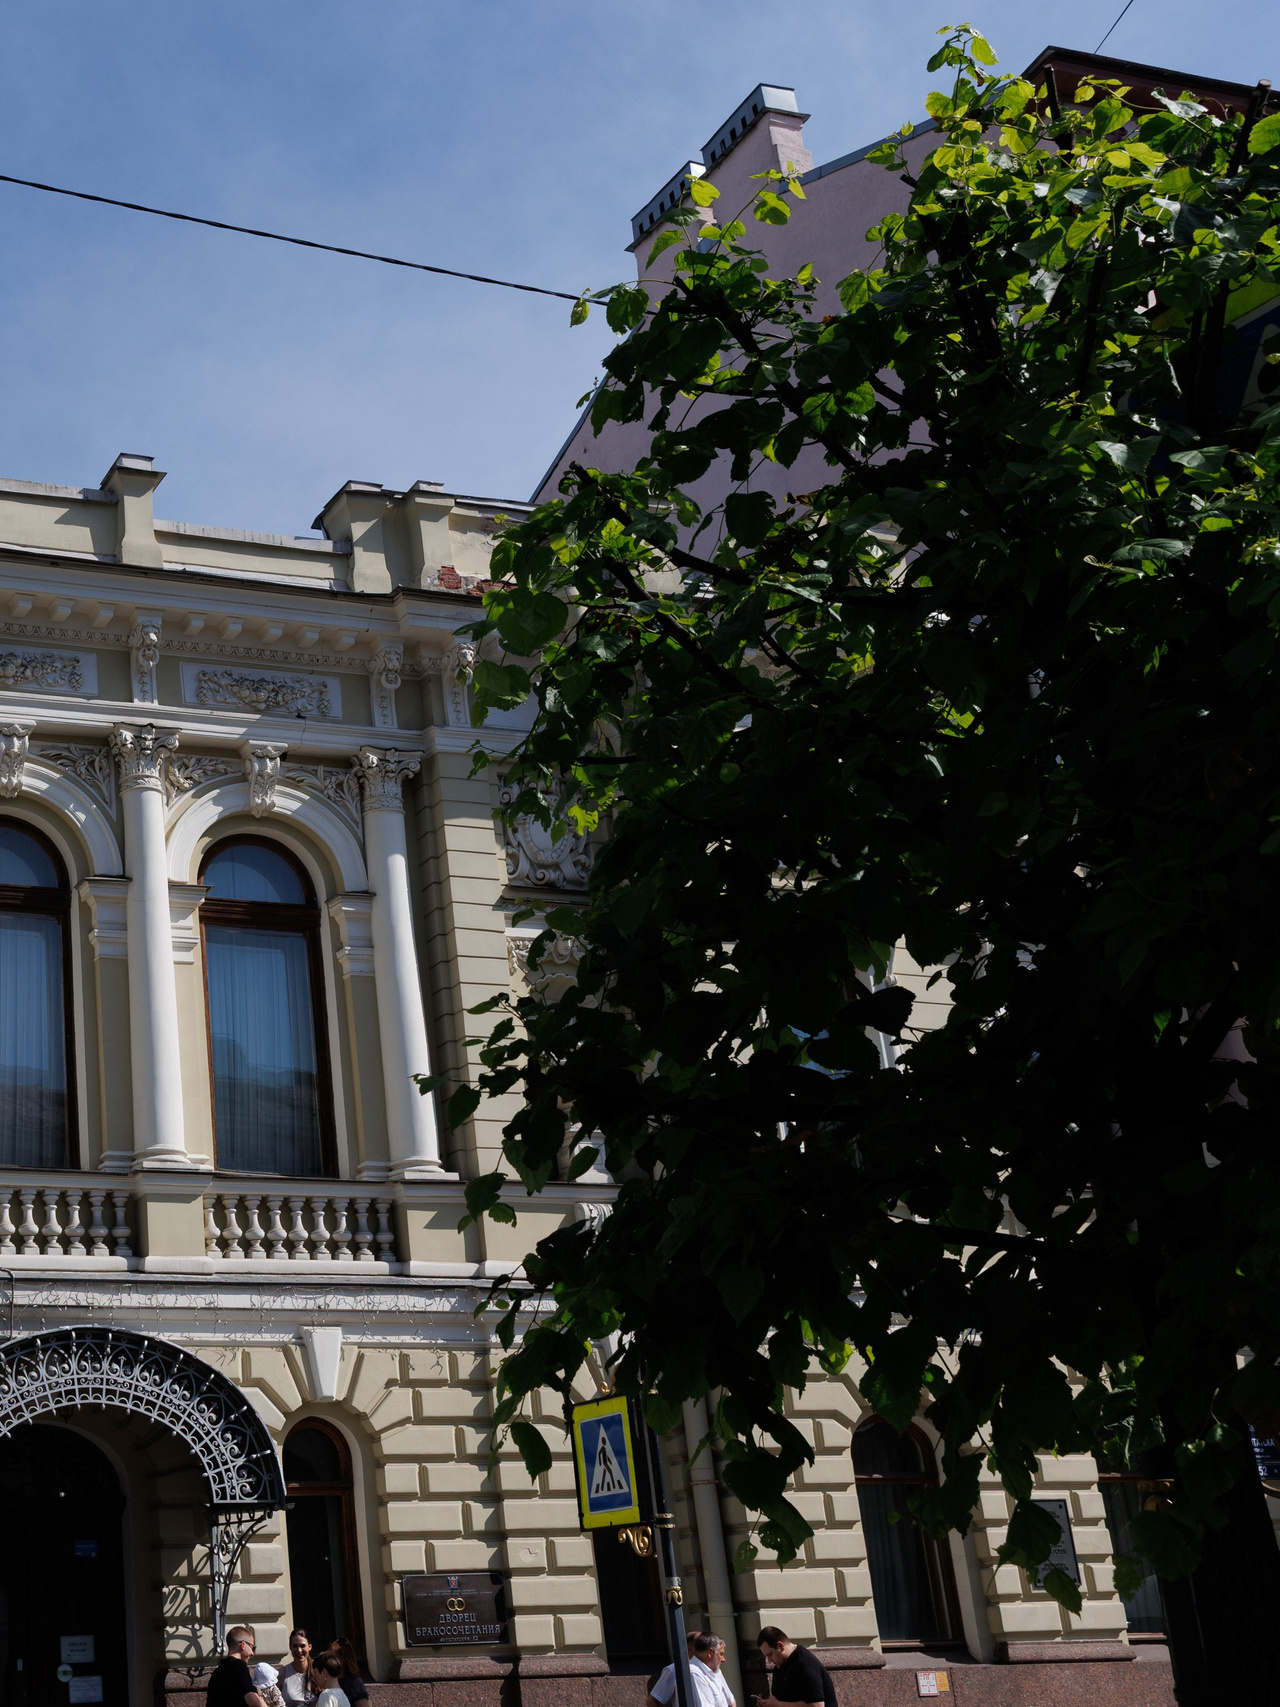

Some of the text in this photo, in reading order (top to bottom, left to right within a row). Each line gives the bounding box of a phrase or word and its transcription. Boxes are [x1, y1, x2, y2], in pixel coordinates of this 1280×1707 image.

[1258, 1465, 1268, 1476] 52
[439, 1614, 476, 1623] ДВОРЕЦ
[416, 1625, 500, 1636] БРАКОСОЧЕТАНИЯ
